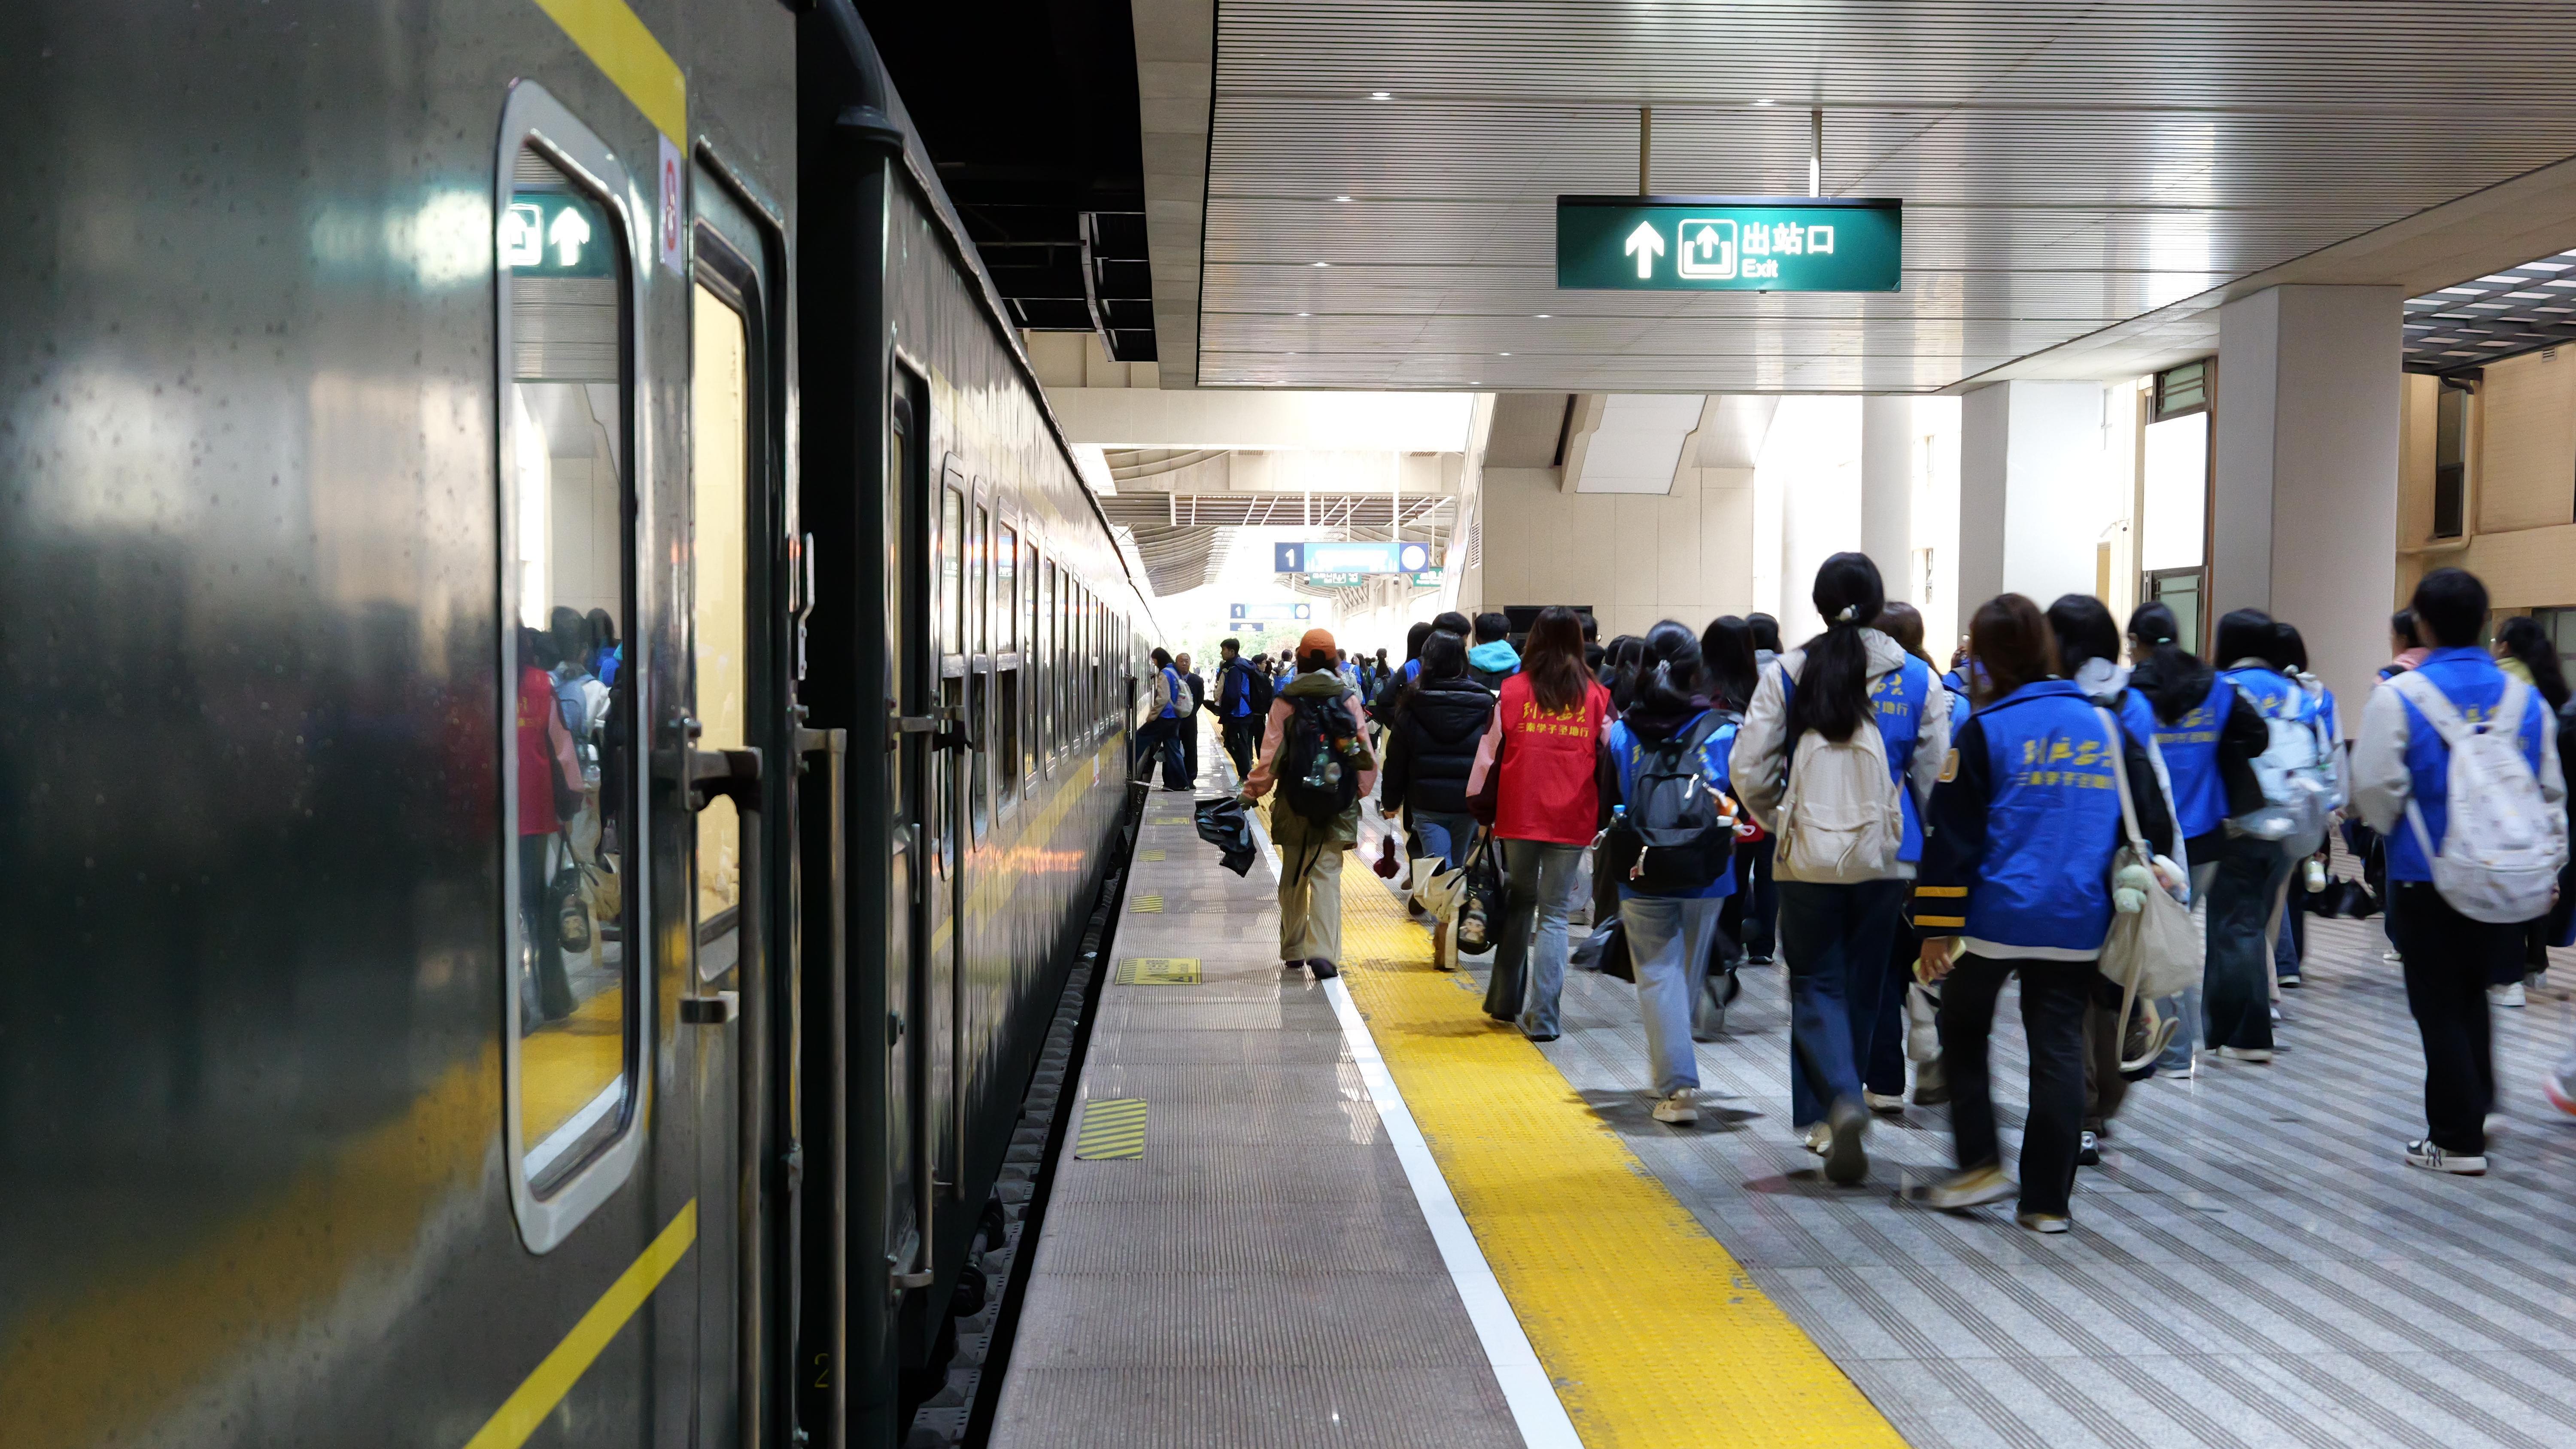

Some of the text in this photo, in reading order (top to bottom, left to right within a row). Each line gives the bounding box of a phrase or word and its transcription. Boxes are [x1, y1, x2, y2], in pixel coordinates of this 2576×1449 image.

[1742, 222, 1834, 255] 出站口
[1742, 258, 1778, 277] Exit
[1285, 548, 1294, 567] 1
[1236, 606, 1241, 617] 1
[814, 1353, 829, 1388] 2
